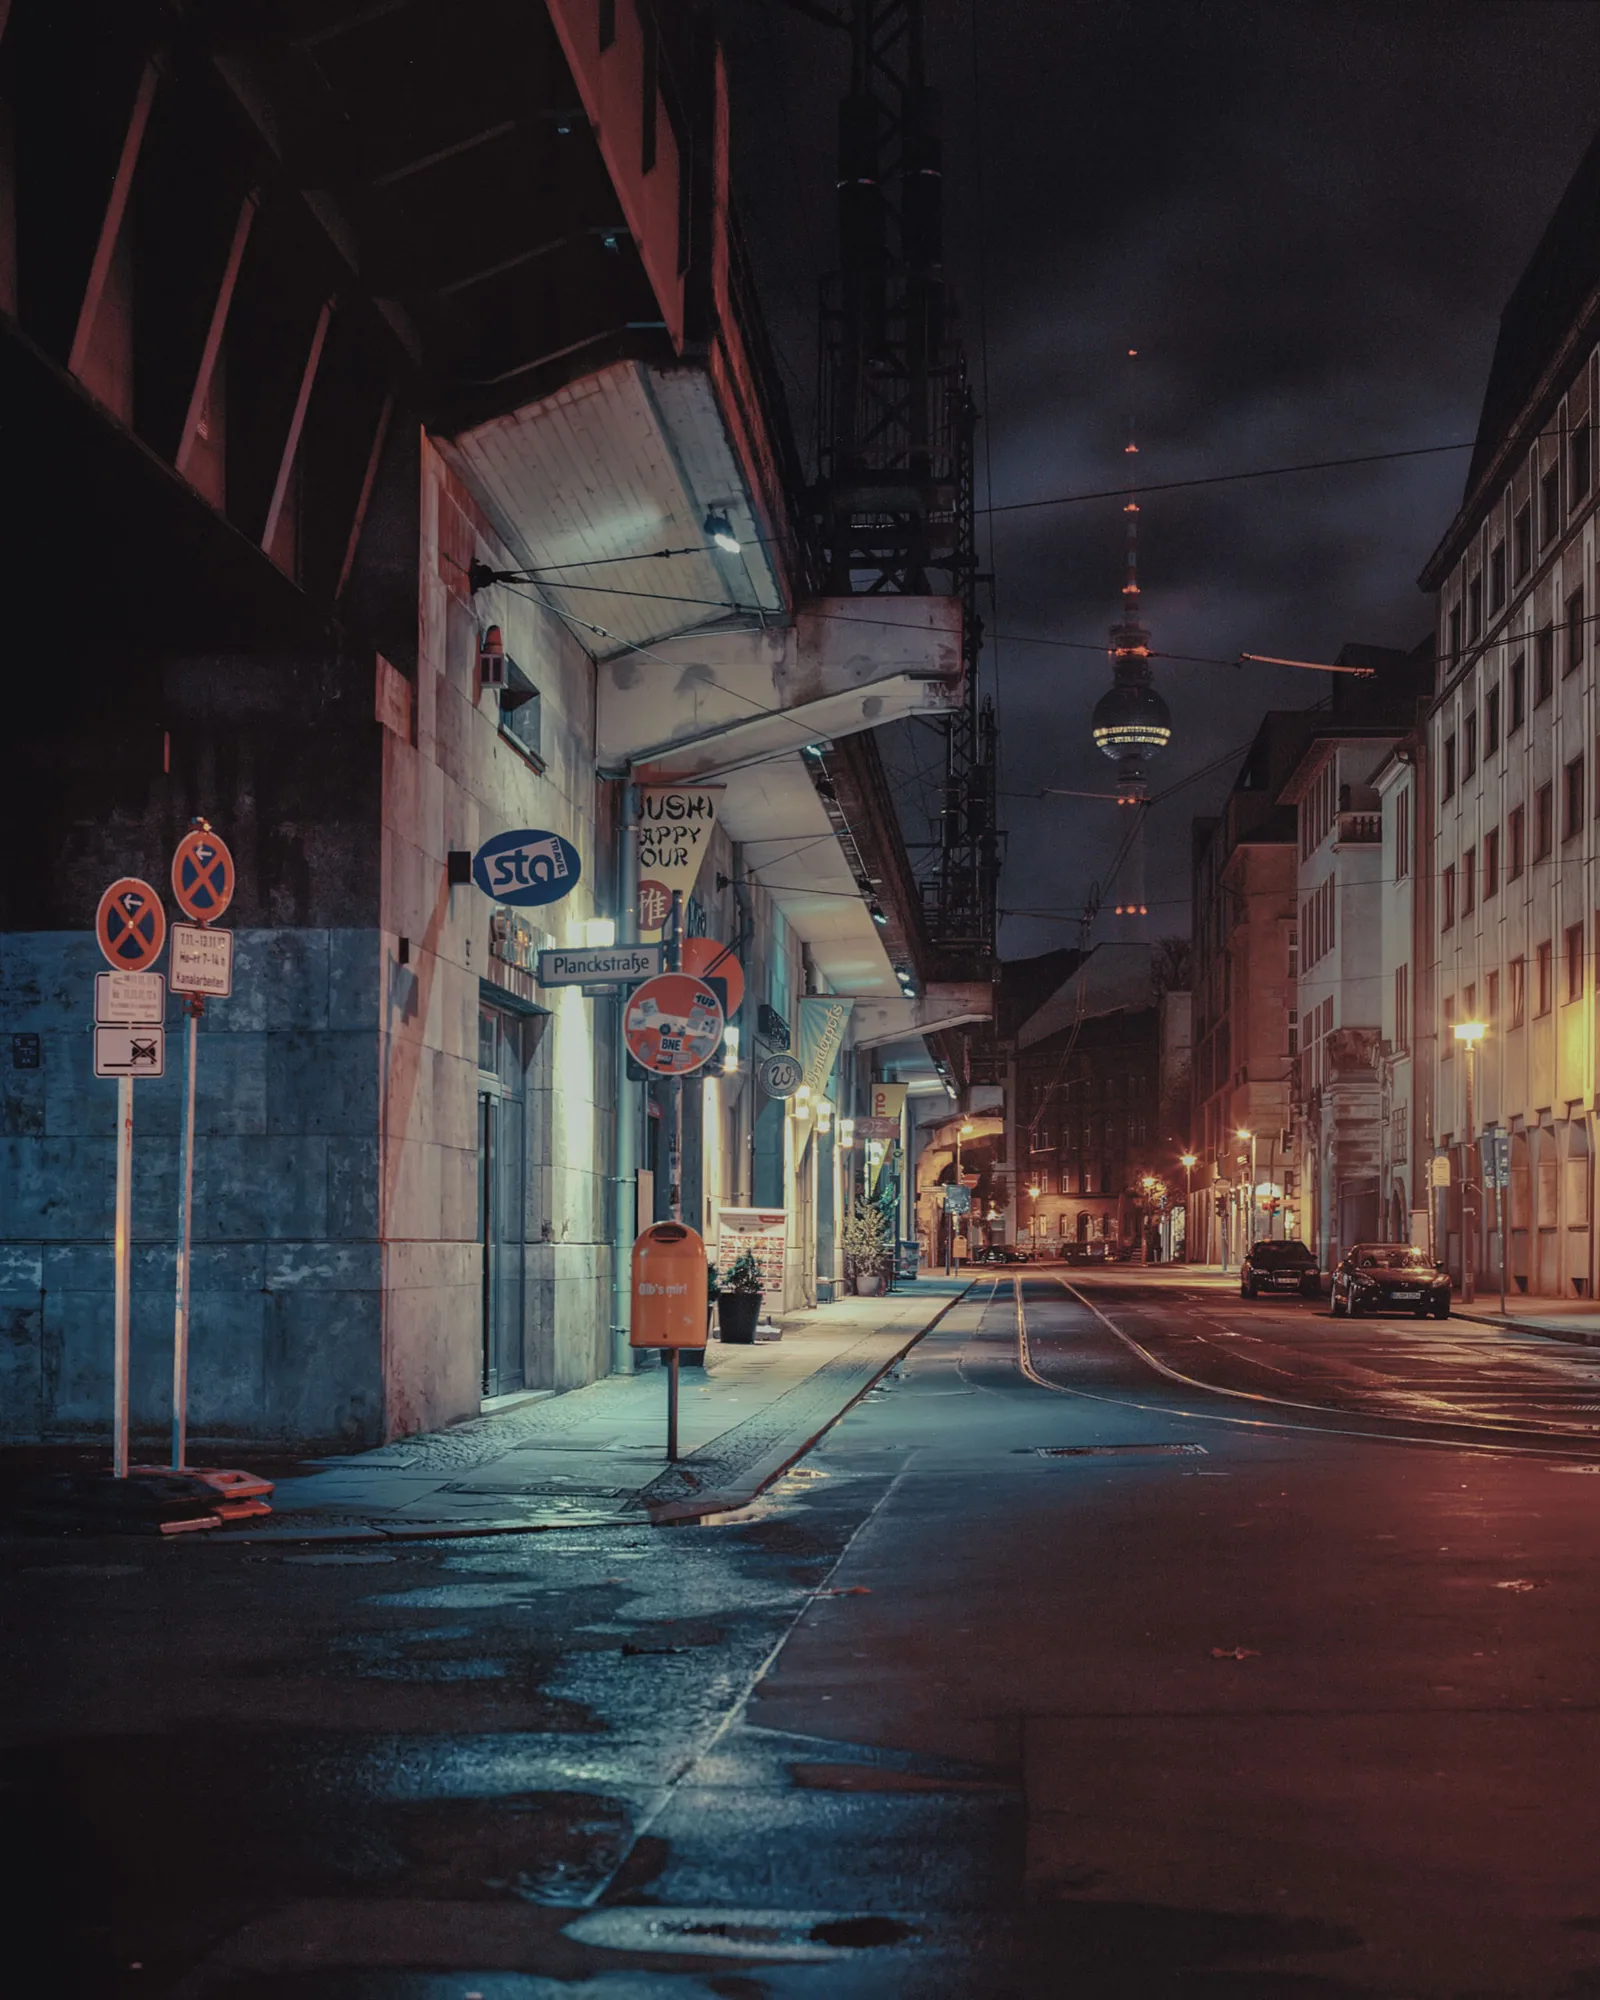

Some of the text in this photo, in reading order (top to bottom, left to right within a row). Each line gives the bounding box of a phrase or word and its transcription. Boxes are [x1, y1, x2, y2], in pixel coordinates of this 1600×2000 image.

[637, 826, 701, 846] APPY
[493, 848, 554, 886] sta
[550, 839, 566, 875] TRAVEL
[637, 847, 688, 867] OUR
[553, 953, 649, 974] Planckstraße
[695, 994, 716, 1008] 1UP
[661, 1038, 681, 1051] BNE
